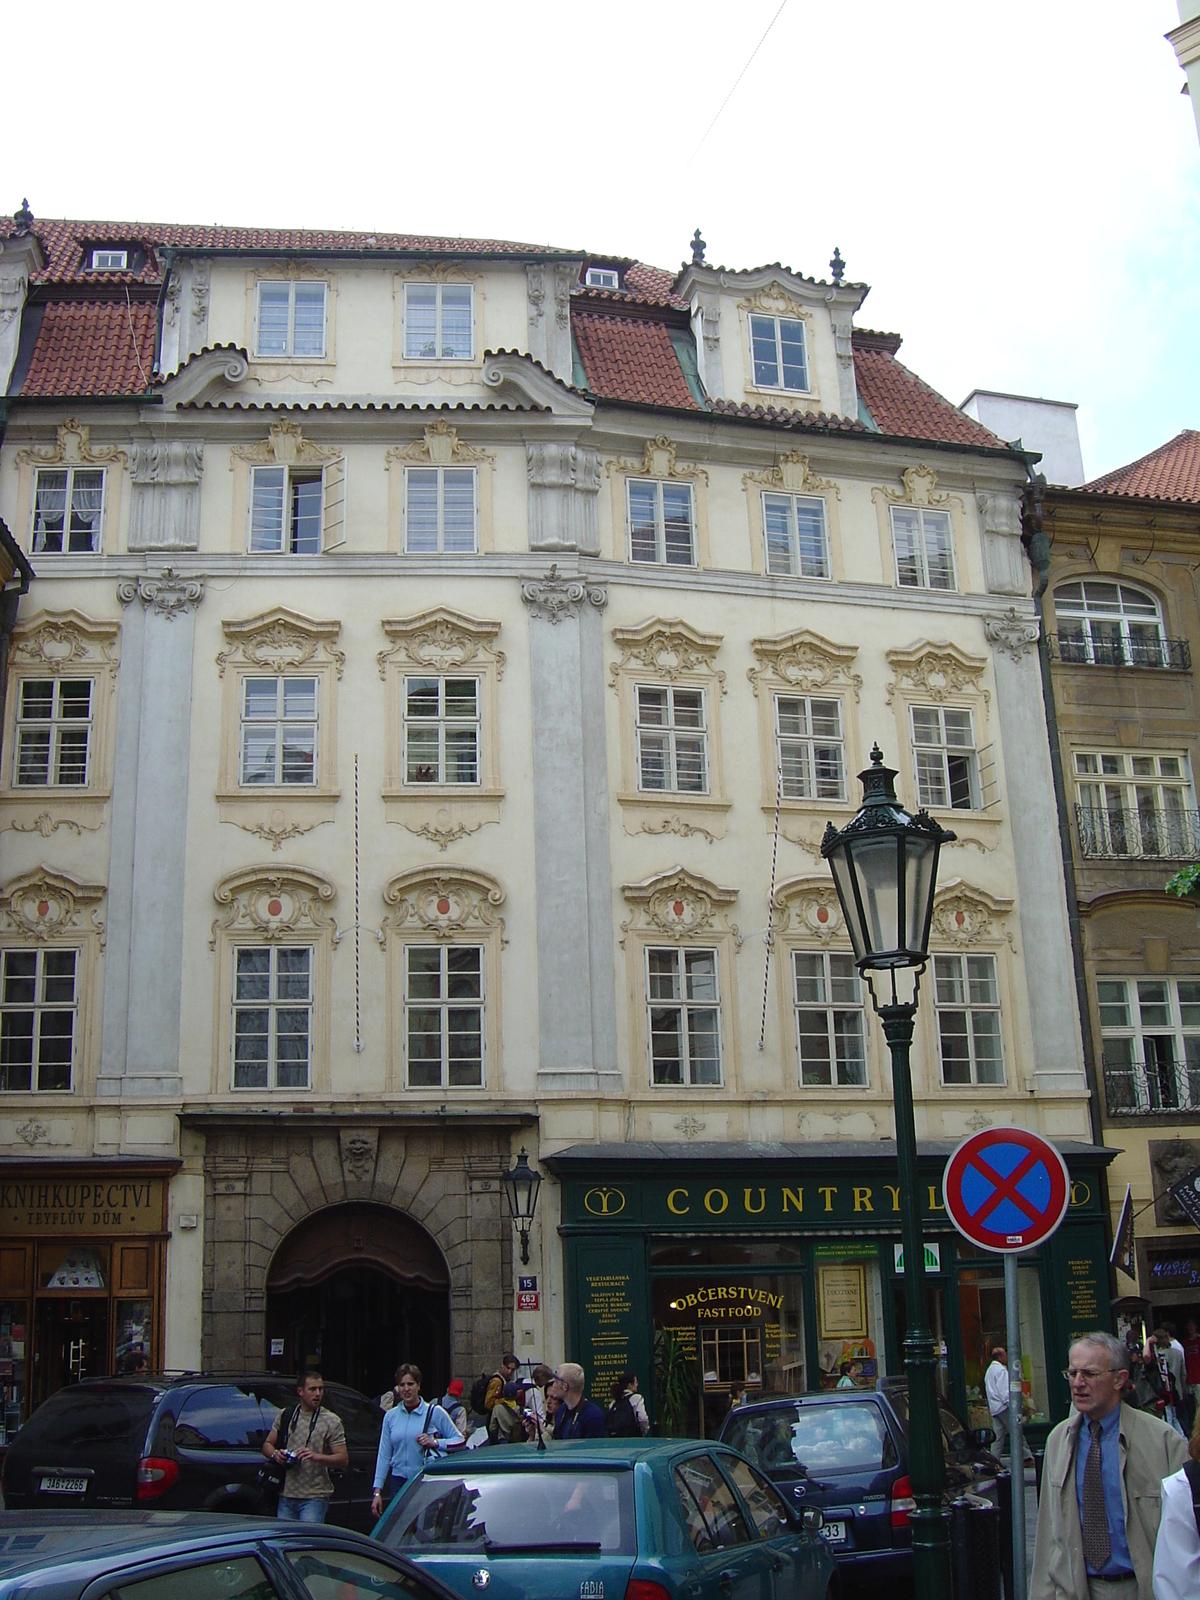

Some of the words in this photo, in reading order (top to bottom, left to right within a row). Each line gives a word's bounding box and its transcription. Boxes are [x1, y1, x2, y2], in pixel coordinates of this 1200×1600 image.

[0, 1181, 151, 1208] KNIHKUPECTVÍ
[667, 1186, 901, 1214] COUNTRY
[27, 1210, 85, 1225] TEYFLŮV
[93, 1210, 122, 1225] DŮM
[523, 1279, 532, 1288] 15
[521, 1294, 536, 1303] 463
[676, 1286, 784, 1310] OBČERSTVENÍ
[697, 1307, 726, 1318] FAST
[729, 1306, 762, 1317] FOOD
[46, 1478, 60, 1489] 3A6
[65, 1479, 84, 1490] 2266
[821, 1524, 840, 1538] 33
[580, 1581, 604, 1595] FABIA
